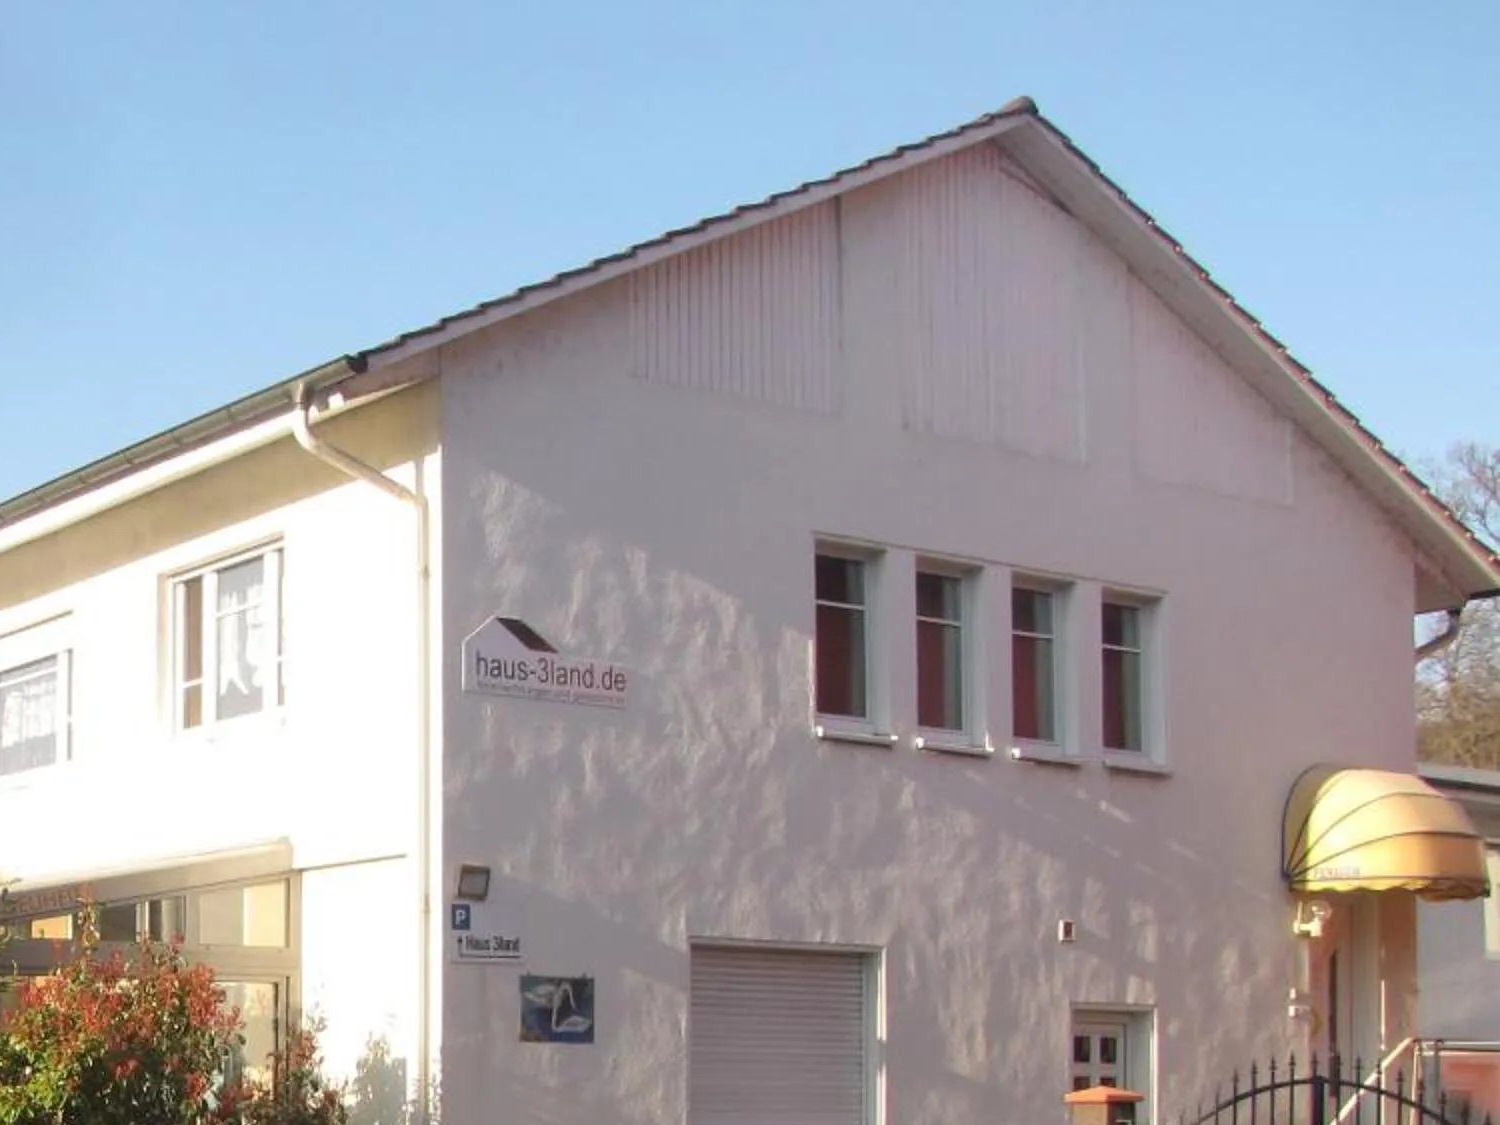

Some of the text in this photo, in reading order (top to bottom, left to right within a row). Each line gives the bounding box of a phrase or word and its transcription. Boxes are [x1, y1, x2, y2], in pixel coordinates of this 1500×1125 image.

[475, 650, 627, 692] haus-3land.de
[455, 909, 467, 925] P
[465, 936, 490, 951] Haus
